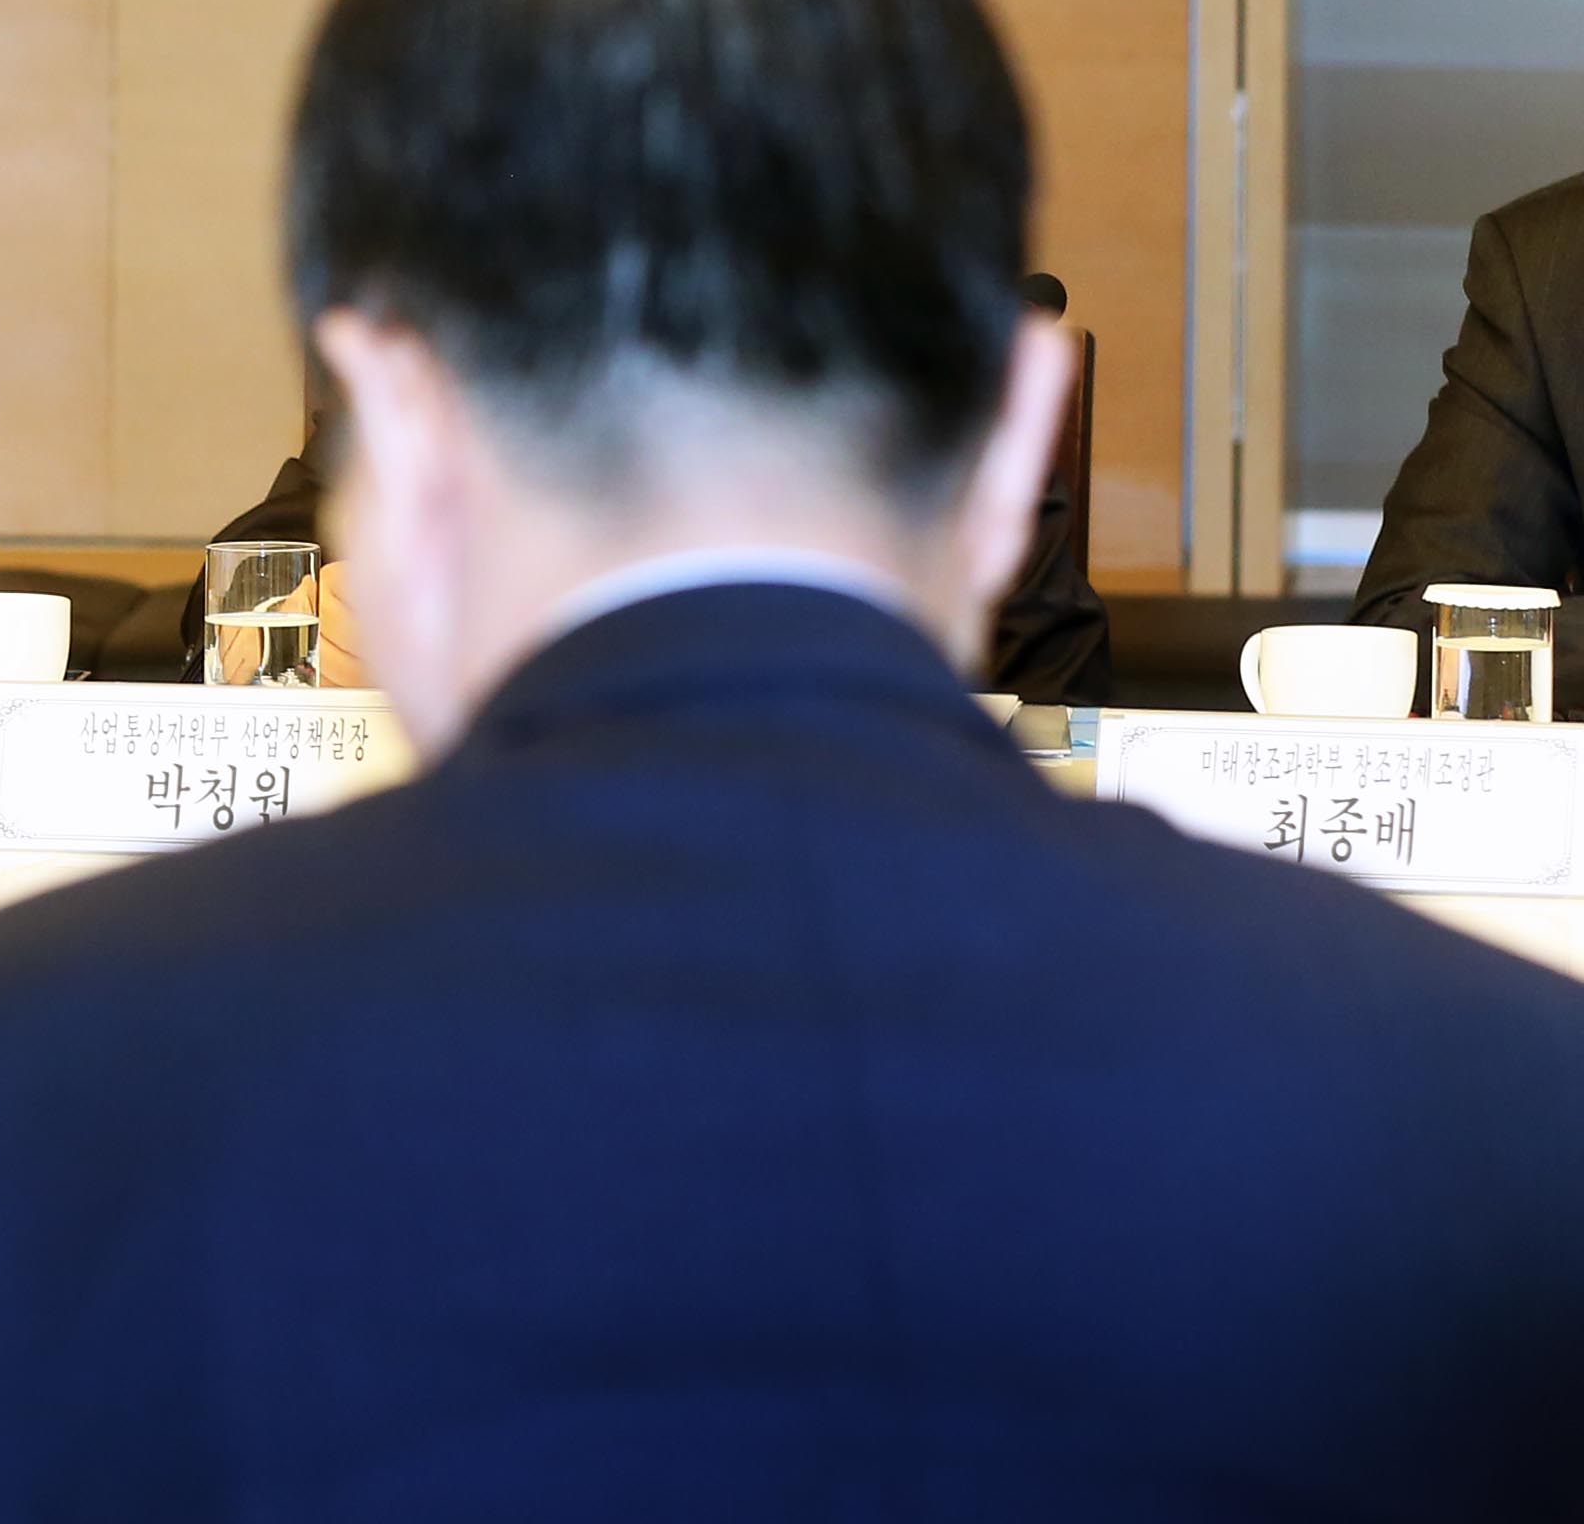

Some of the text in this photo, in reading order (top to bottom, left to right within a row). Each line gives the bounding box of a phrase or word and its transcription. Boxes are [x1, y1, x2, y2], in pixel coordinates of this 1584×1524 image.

[80, 711, 371, 763] 산업통상자원부 산업정책실장
[1200, 739, 1497, 794] 미래창조과학부 창조경제조정관
[146, 763, 294, 831] 박청원
[1262, 794, 1417, 867] 최종배
